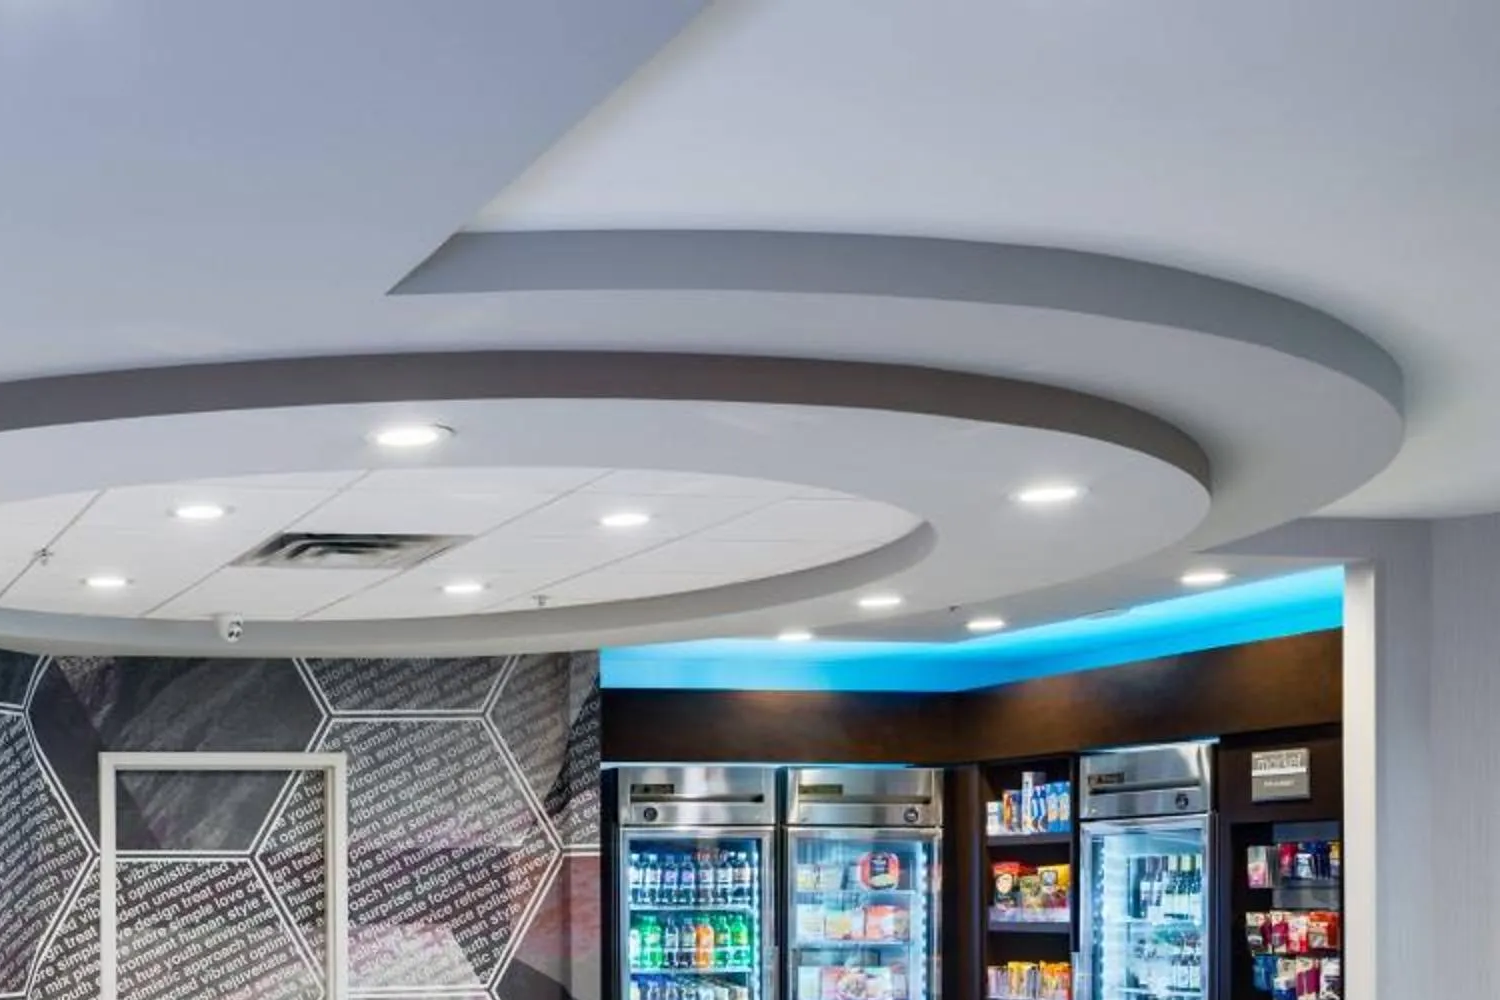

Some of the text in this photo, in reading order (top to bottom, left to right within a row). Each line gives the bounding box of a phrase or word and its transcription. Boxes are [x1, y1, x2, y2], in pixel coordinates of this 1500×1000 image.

[347, 751, 415, 791] vironment
[267, 833, 324, 866] unexpec
[280, 814, 324, 843] optimi
[348, 819, 380, 843] dern
[348, 857, 374, 880] tyle
[348, 861, 403, 898] ronment
[348, 887, 383, 913] oach
[384, 874, 411, 894] hue
[411, 853, 451, 882] youth
[428, 881, 467, 906] focus
[468, 866, 491, 887] fun
[491, 839, 546, 874] surprise
[453, 879, 500, 909] refresh
[501, 849, 556, 884] rejuvena
[134, 902, 182, 932] design
[181, 885, 215, 909] treat
[358, 889, 414, 927] surprise
[415, 866, 461, 897] delight
[44, 974, 72, 997] mix
[169, 903, 215, 932] simple
[213, 888, 246, 910] love
[179, 915, 226, 945] human
[227, 897, 261, 920] style
[135, 963, 162, 984] hue
[163, 942, 203, 972] youth
[182, 938, 246, 978] approach
[247, 925, 275, 945] hue
[199, 955, 248, 986] vibrant
